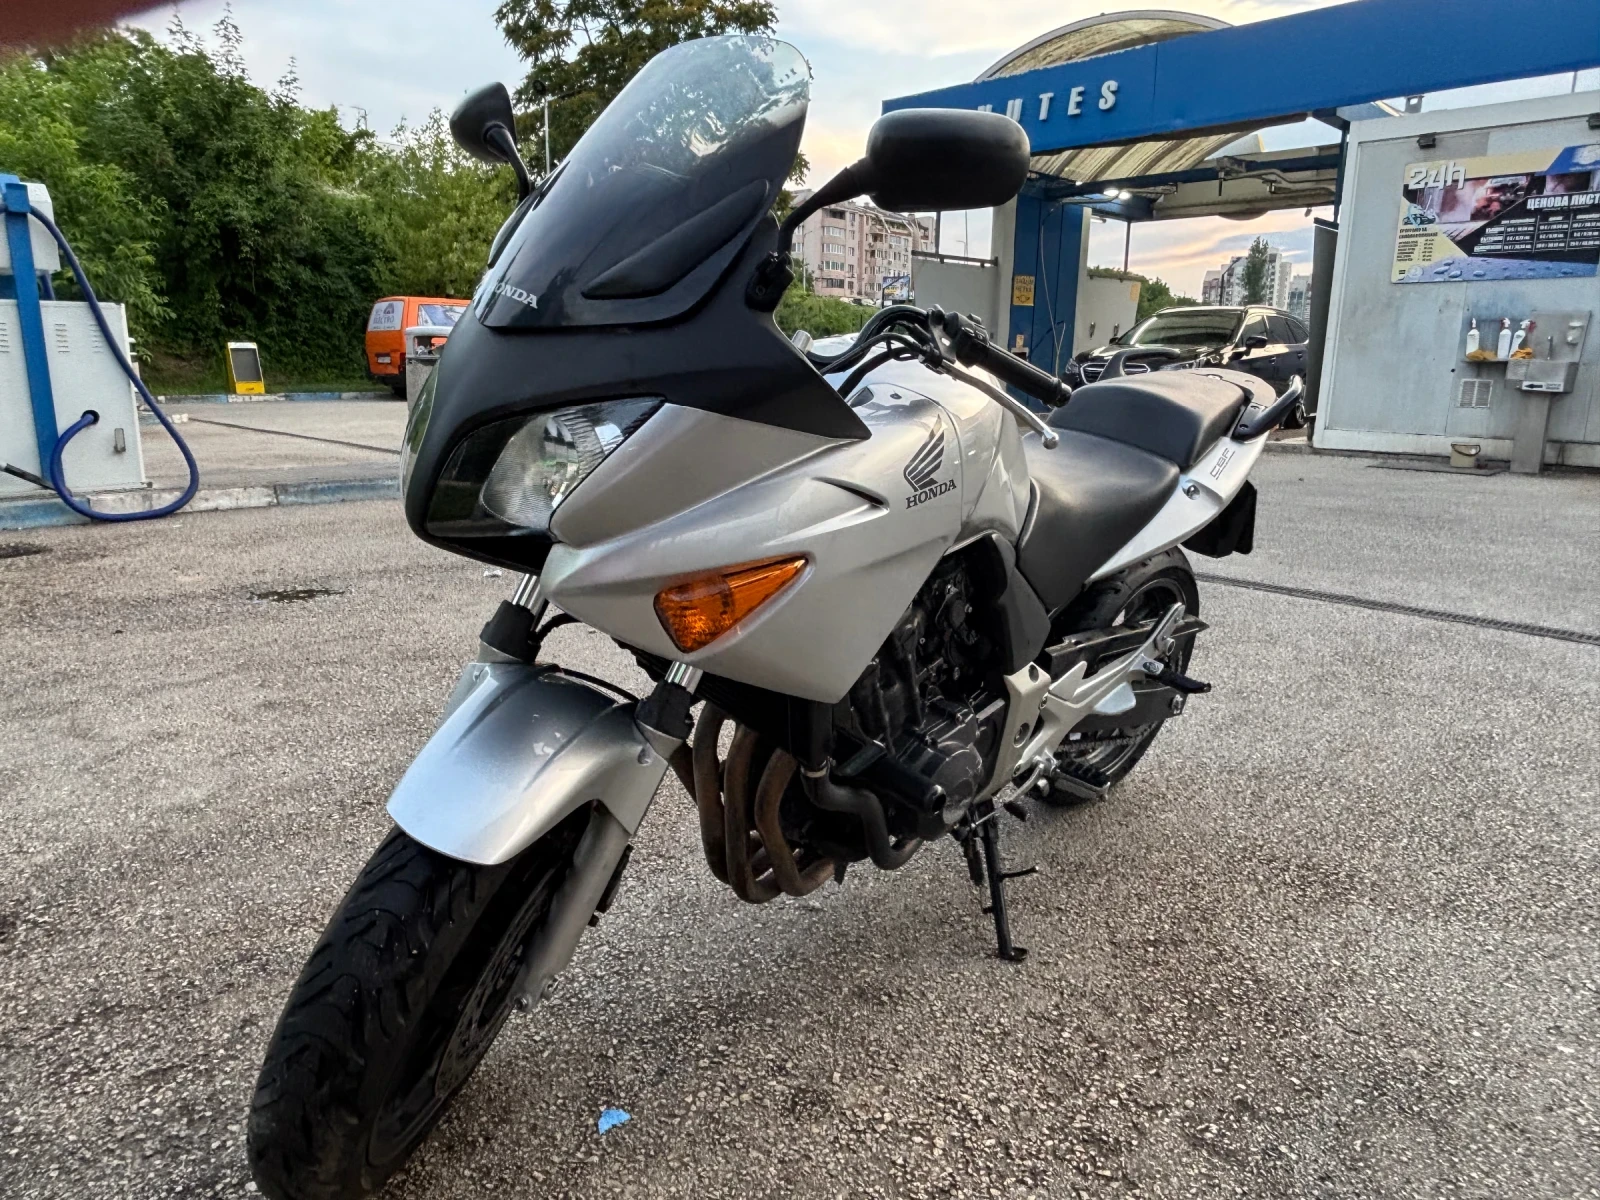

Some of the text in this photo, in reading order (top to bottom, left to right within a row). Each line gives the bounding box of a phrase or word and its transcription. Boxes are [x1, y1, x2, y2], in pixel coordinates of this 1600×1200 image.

[978, 80, 1119, 124] UTES
[1408, 161, 1466, 190] 24h
[1526, 192, 1600, 211] ЦЕНОВА ЛИСТ
[494, 281, 538, 309] ONDA
[1210, 448, 1230, 478] CBF
[906, 479, 957, 510] HONDA
